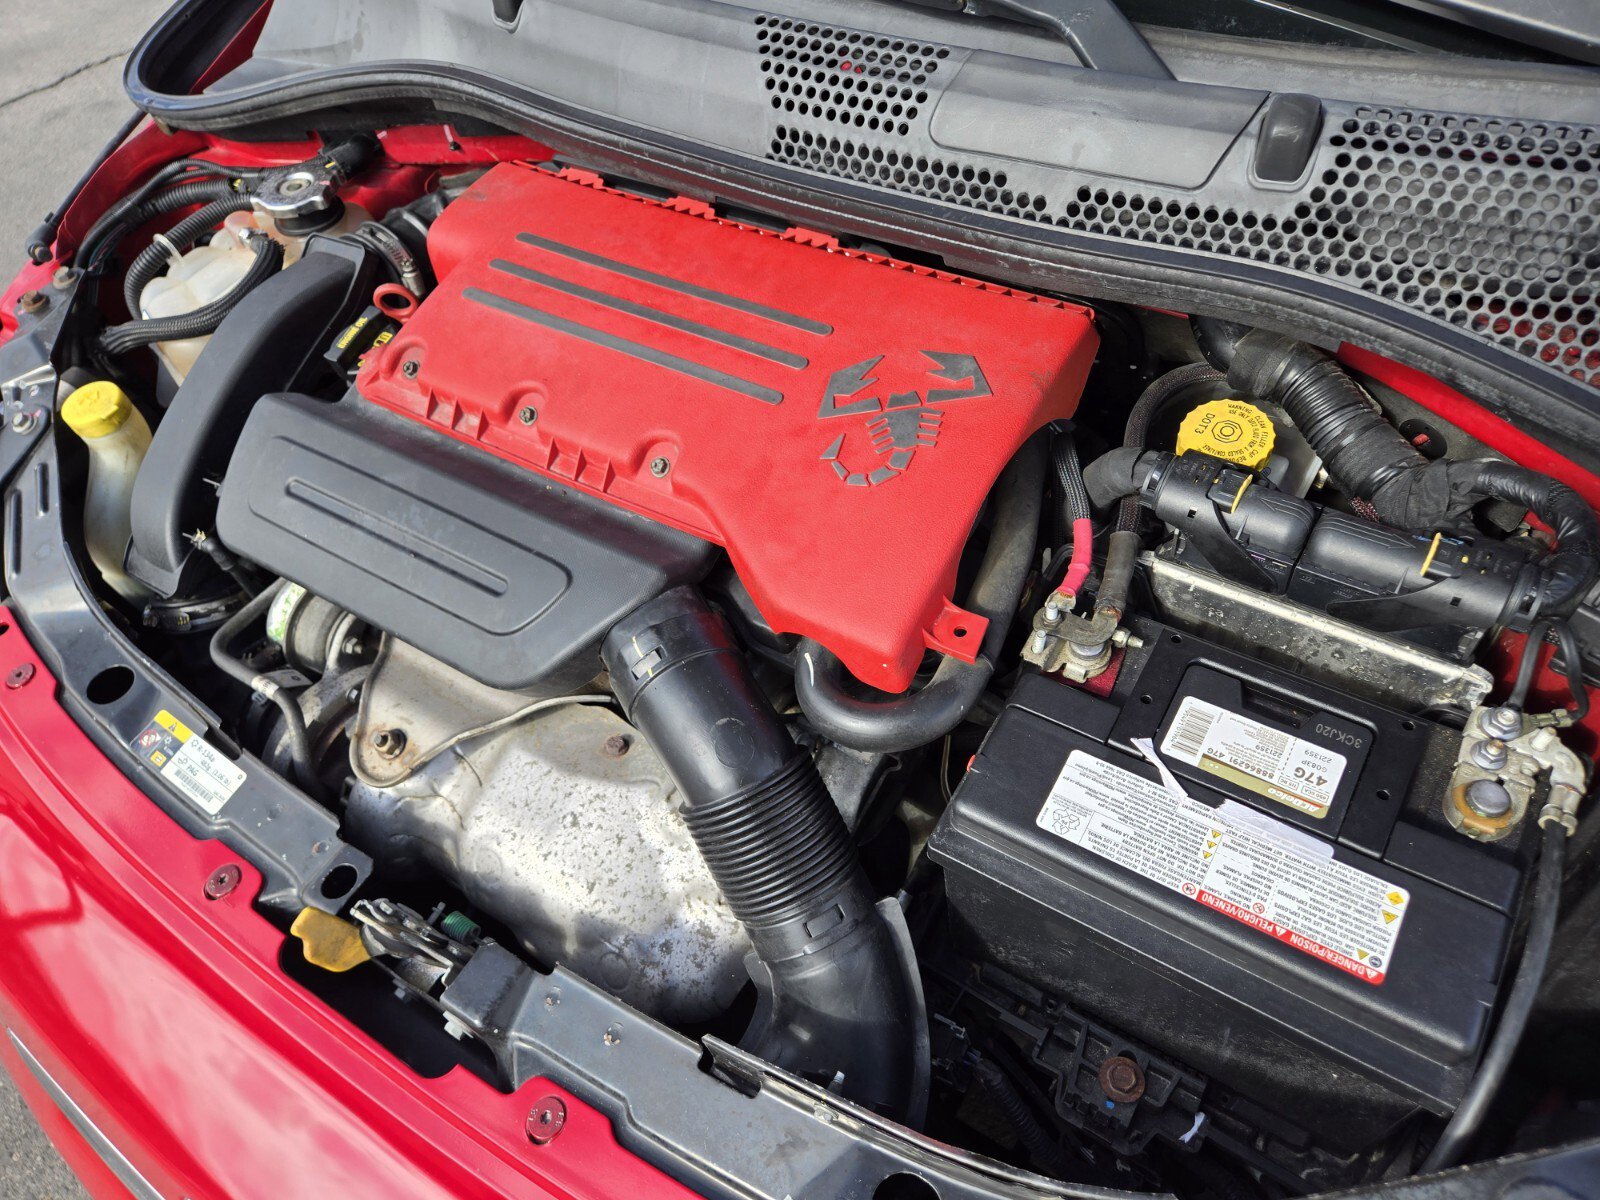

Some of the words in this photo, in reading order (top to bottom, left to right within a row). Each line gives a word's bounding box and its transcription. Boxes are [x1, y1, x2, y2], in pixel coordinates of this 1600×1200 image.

[336, 326, 360, 349] ENGINE
[355, 317, 368, 328] OIL
[1194, 413, 1215, 434] DOT3
[1255, 416, 1266, 429] CLEAN
[1248, 438, 1258, 448] FROM
[1259, 432, 1268, 448] FILLER
[1228, 449, 1243, 457] SEALED
[1249, 450, 1259, 458] CAP
[1315, 723, 1362, 749] 3CKJ20
[1205, 746, 1225, 759] 47G
[1254, 743, 1282, 758] 221359
[1303, 748, 1332, 764] 221359
[186, 764, 200, 777] PAG
[1228, 756, 1275, 779] 88866291
[1292, 765, 1328, 788] 47G
[1200, 891, 1274, 932] PELIGRO/VENENO
[1290, 933, 1365, 973] DANGER/POISON
